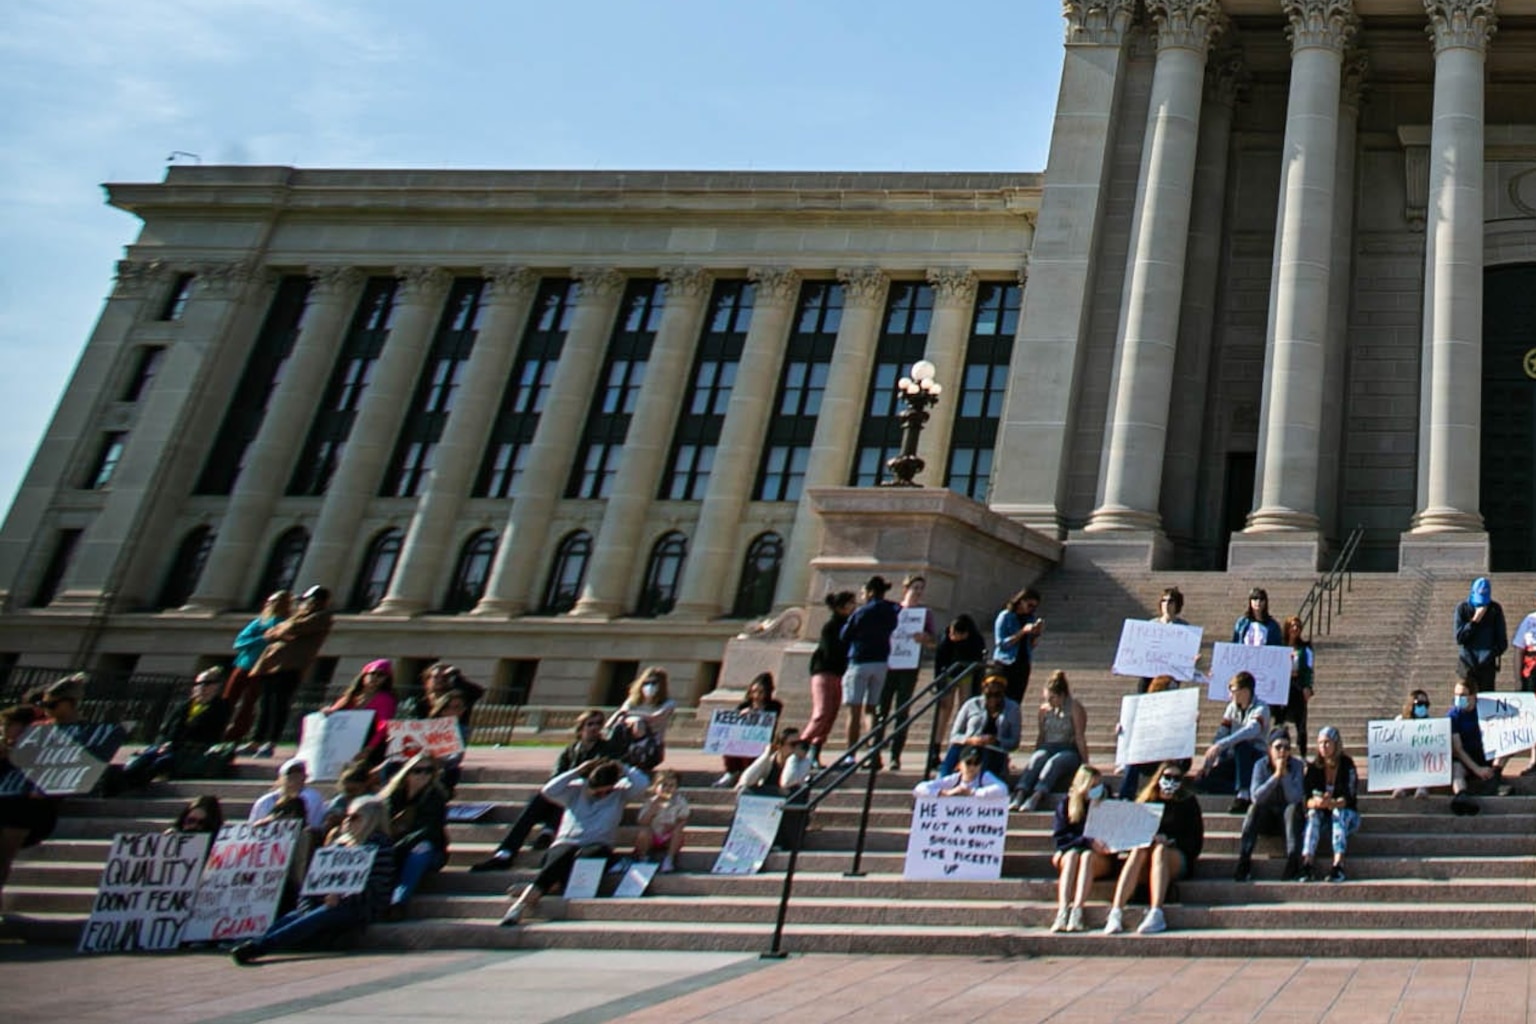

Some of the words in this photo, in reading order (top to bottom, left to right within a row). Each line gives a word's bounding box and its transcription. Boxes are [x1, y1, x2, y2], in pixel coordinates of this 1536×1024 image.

[1496, 697, 1522, 713] NO
[920, 802, 937, 818] HE
[946, 807, 973, 817] WHO
[977, 807, 1004, 817] HATH
[216, 826, 232, 841] I
[920, 821, 949, 831] NOT
[954, 825, 962, 833] A
[968, 824, 1004, 836] UTERUS
[116, 835, 160, 857] MEN
[163, 835, 194, 857] OF
[929, 835, 967, 846] SHOULD
[968, 839, 995, 848] SHUT
[208, 843, 289, 870] WOMEN
[922, 848, 945, 859] THE
[105, 858, 199, 886] QUALITY
[944, 864, 959, 874] UP
[146, 890, 195, 912] FEAR
[84, 916, 187, 951] EQUALITY
[212, 915, 268, 940] GUNS
